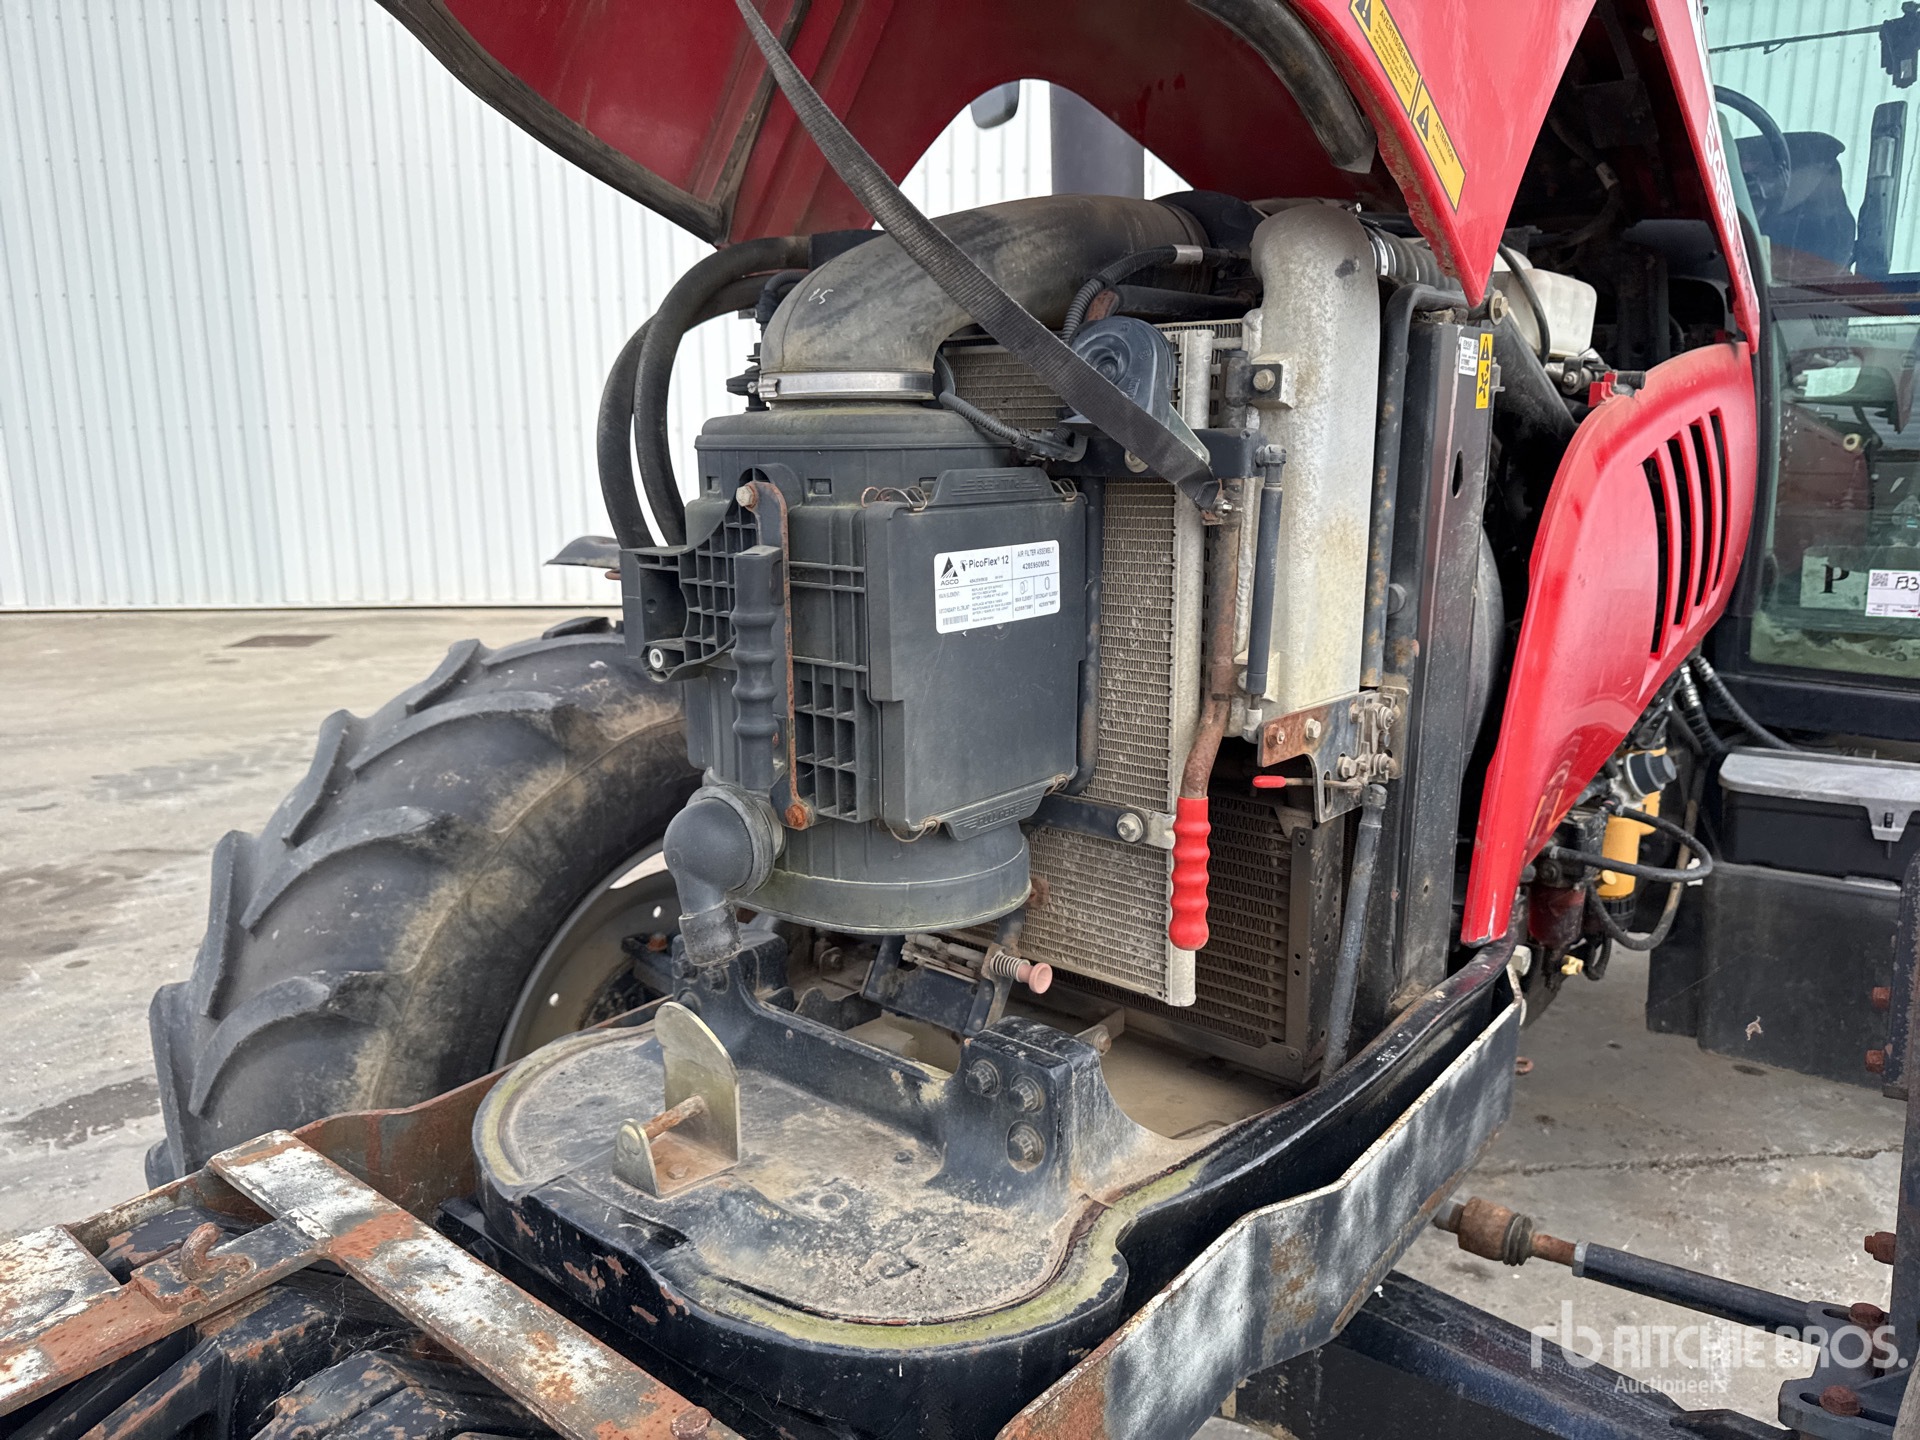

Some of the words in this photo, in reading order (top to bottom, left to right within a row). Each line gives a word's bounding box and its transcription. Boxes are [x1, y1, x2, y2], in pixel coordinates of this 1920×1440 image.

[1379, 9, 1416, 79] AVERTISSEMENT
[1434, 120, 1455, 164] ATTENTION
[1001, 555, 1009, 565] 12
[940, 578, 959, 586] AGCO
